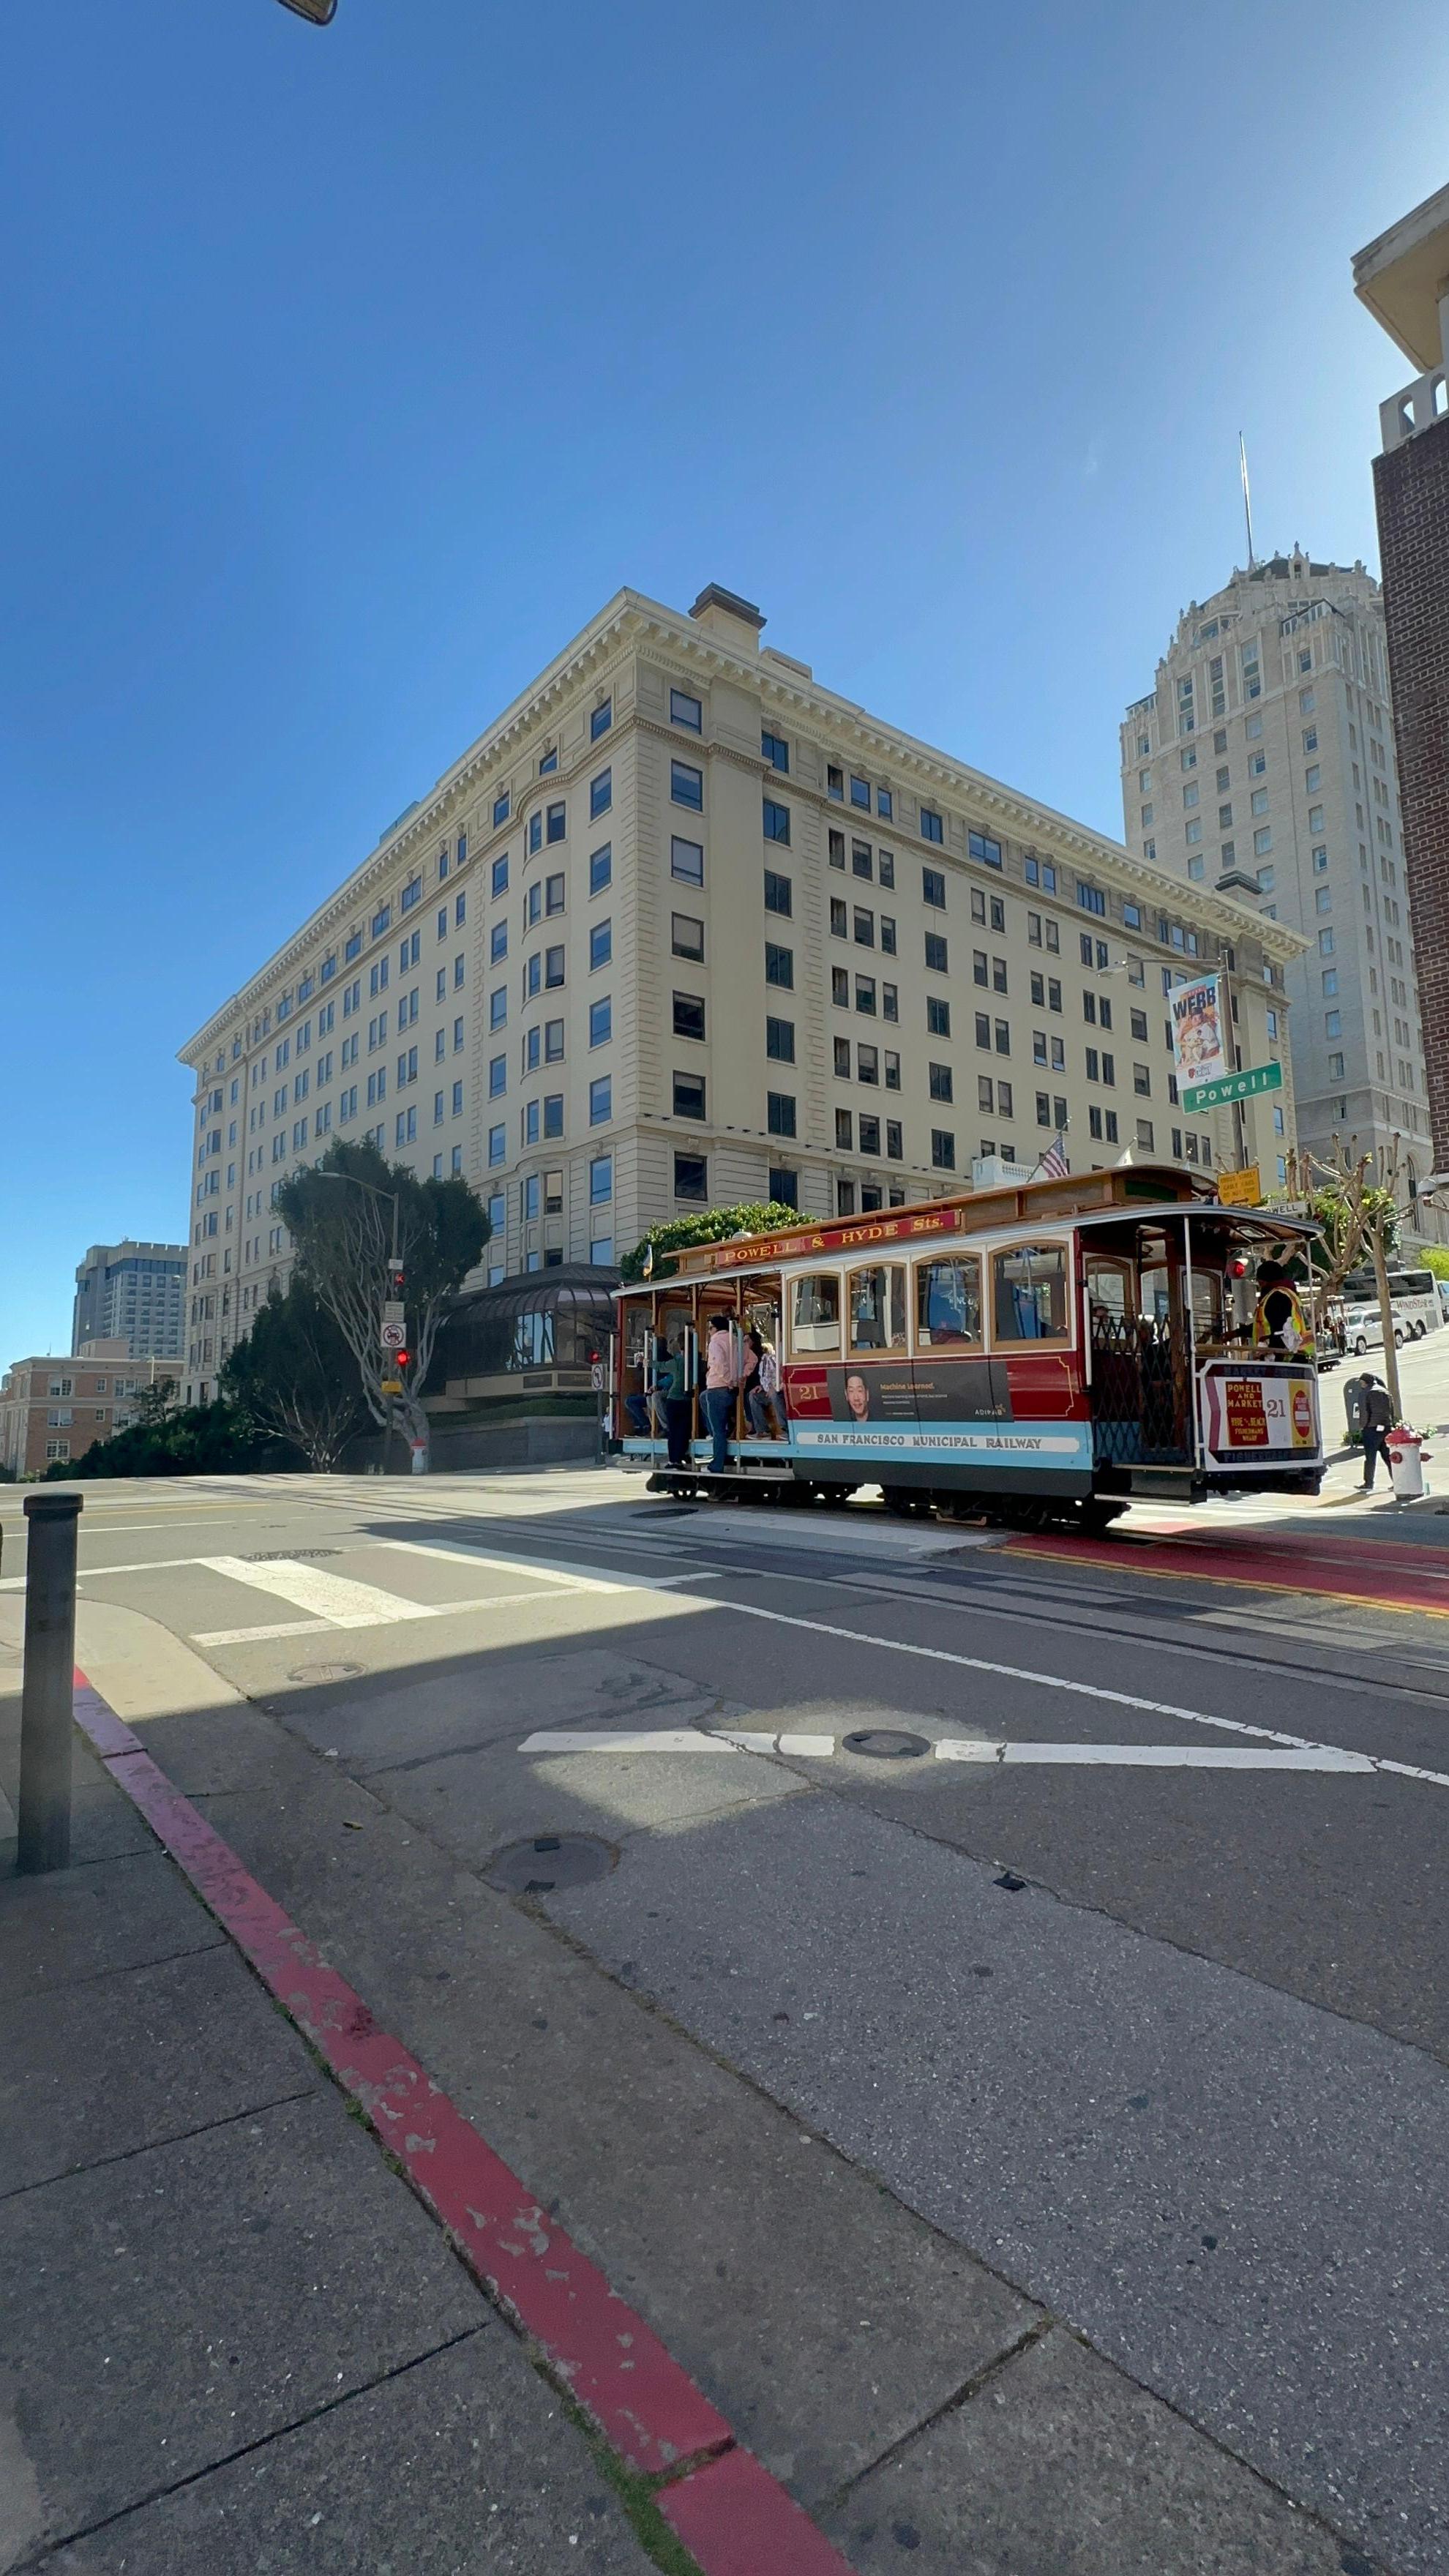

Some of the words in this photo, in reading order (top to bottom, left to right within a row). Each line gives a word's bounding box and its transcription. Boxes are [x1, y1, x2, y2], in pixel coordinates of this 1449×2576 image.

[1172, 986, 1216, 1020] WEBB
[1196, 1072, 1268, 1104] Powell
[1265, 1205, 1298, 1216] OWELL
[724, 1242, 797, 1262] POWELL
[812, 1236, 825, 1248] &
[842, 1224, 898, 1244] HYDE
[913, 1216, 944, 1230] Sts.
[799, 1385, 819, 1400] 21
[1227, 1384, 1262, 1393] POWELL
[1227, 1399, 1262, 1408] MARKET
[1267, 1399, 1286, 1418] 21
[817, 1434, 838, 1443] SAN
[842, 1434, 905, 1446] FRANCISCO
[913, 1436, 977, 1448] MUNICIPAL
[986, 1437, 1041, 1450] RAILWAY
